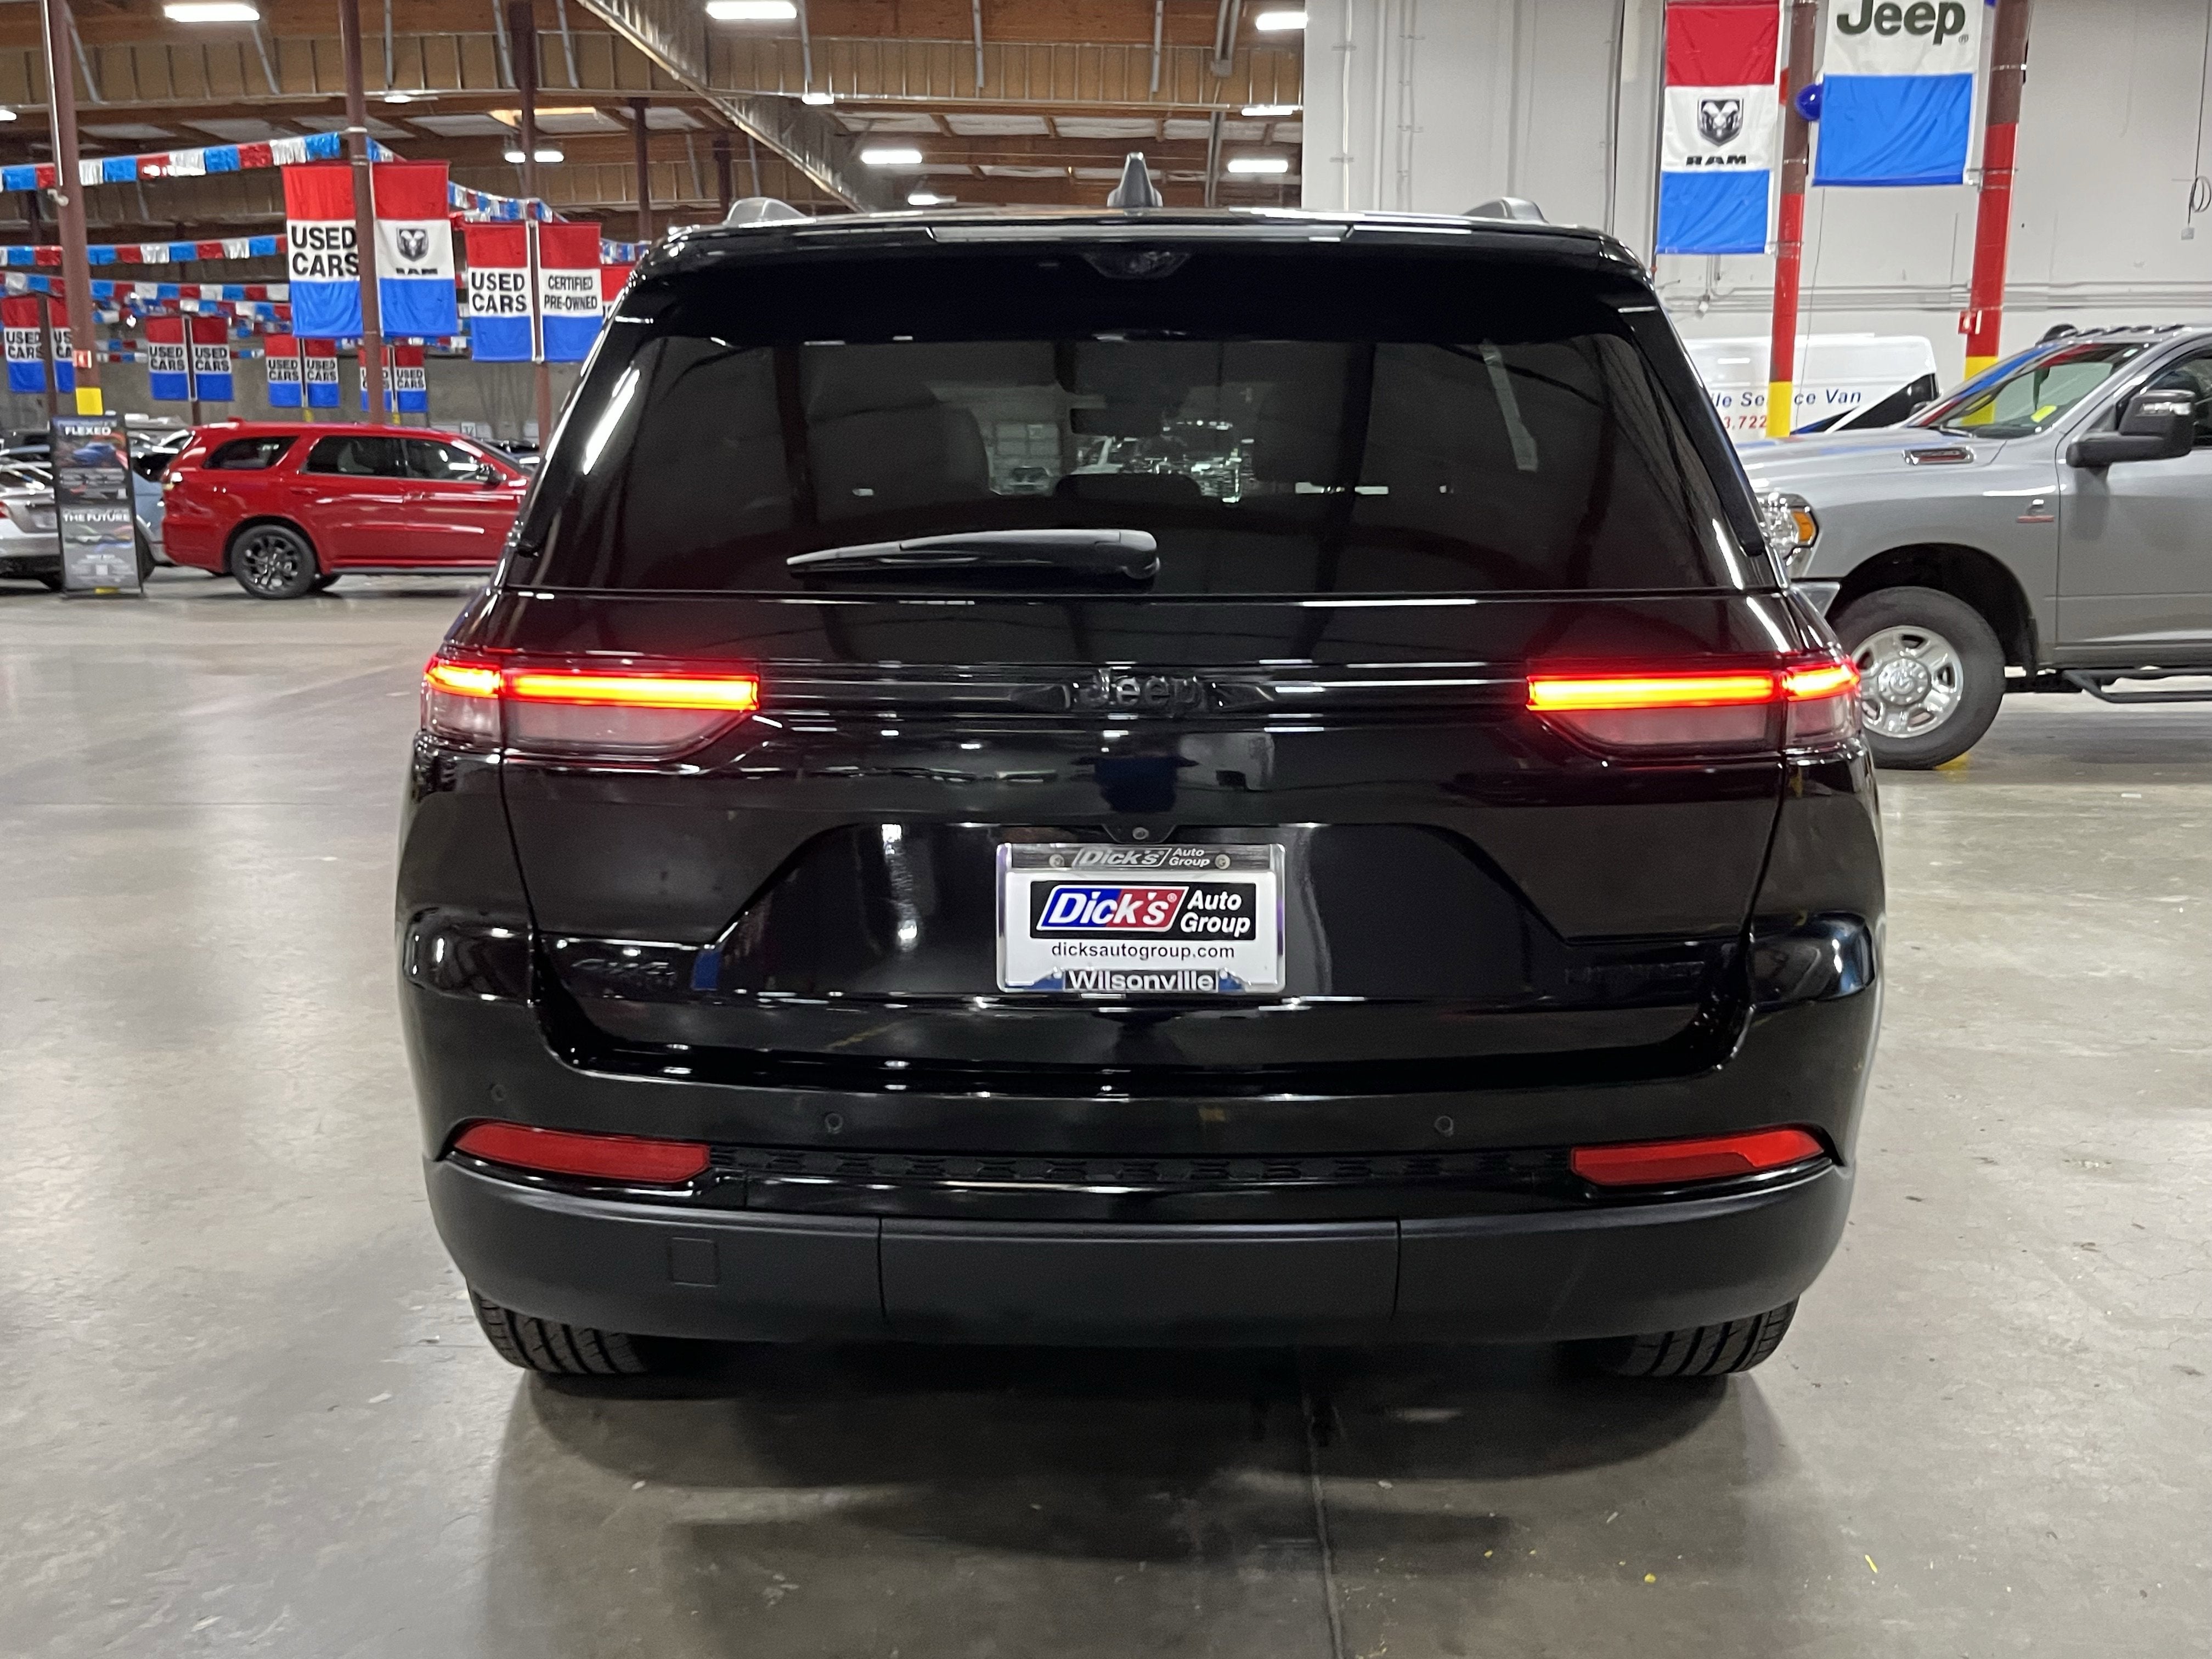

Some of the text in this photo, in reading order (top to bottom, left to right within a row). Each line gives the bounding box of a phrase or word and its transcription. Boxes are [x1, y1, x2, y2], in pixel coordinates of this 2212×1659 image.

[1837, 0, 1966, 46] Jeep
[291, 225, 356, 250] USED
[292, 252, 358, 278] CARS
[471, 272, 525, 291] USED
[549, 275, 593, 291] CERTIFIED
[472, 293, 527, 313] CARS
[544, 295, 597, 310] PRE-OWNED
[149, 346, 183, 357] USED
[195, 347, 228, 359] USED
[150, 358, 185, 371] CARS
[195, 359, 229, 372] CARS
[268, 359, 298, 369] USED
[307, 359, 335, 370] USED
[269, 370, 299, 381] CARS
[307, 371, 337, 381] CARS
[1826, 388, 1861, 404] Van
[65, 426, 111, 436] FLEXED
[63, 513, 131, 522] THE FUTURE
[1079, 850, 1160, 865] Dick's
[1172, 848, 1205, 857] Auto
[1169, 857, 1210, 867] Group
[1187, 889, 1243, 911] Auto
[1048, 891, 1170, 925] Dick's
[1180, 912, 1251, 938] Group
[1051, 942, 1235, 961] dicksautogroup.com
[1068, 970, 1214, 991] Wilsonville
